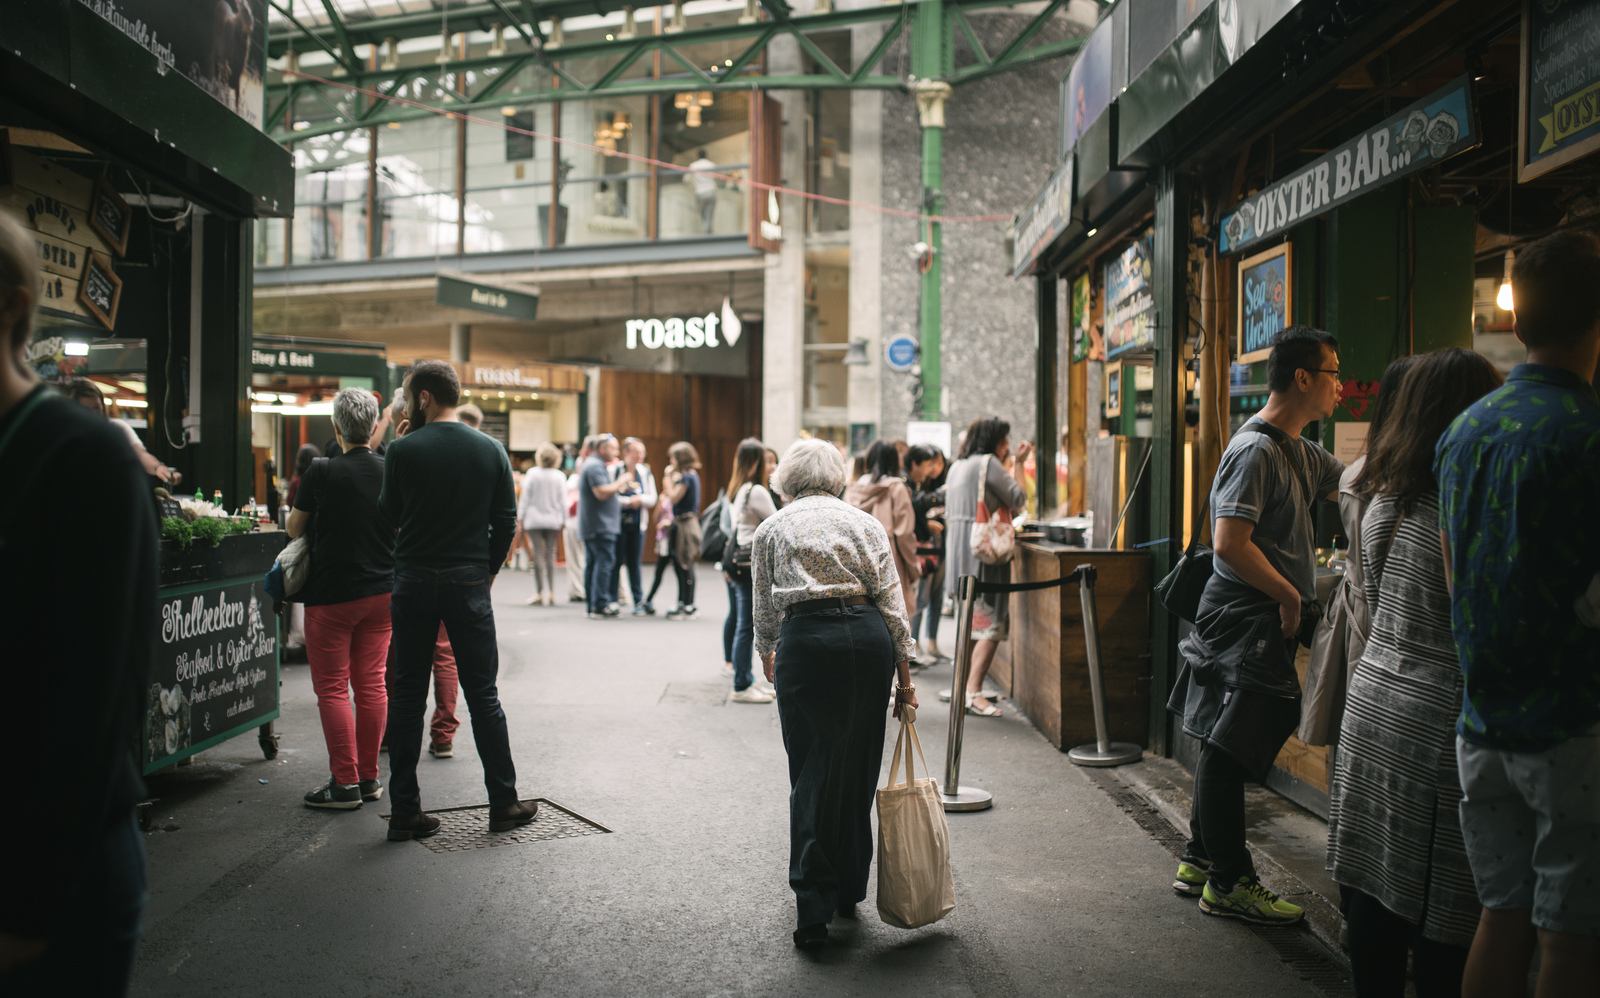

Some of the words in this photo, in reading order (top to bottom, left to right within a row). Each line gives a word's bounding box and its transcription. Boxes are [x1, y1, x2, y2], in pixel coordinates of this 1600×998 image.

[1254, 161, 1330, 238] OYSTER
[1245, 277, 1266, 316] Sea
[625, 311, 720, 349] roast
[1245, 306, 1279, 352] Urchin
[278, 351, 288, 366] &
[475, 367, 520, 385] roast
[162, 590, 244, 643] Shellseekers
[176, 645, 214, 687] Seafood
[217, 642, 223, 670] &
[226, 636, 253, 675] Oyster
[254, 631, 276, 658] Bar
